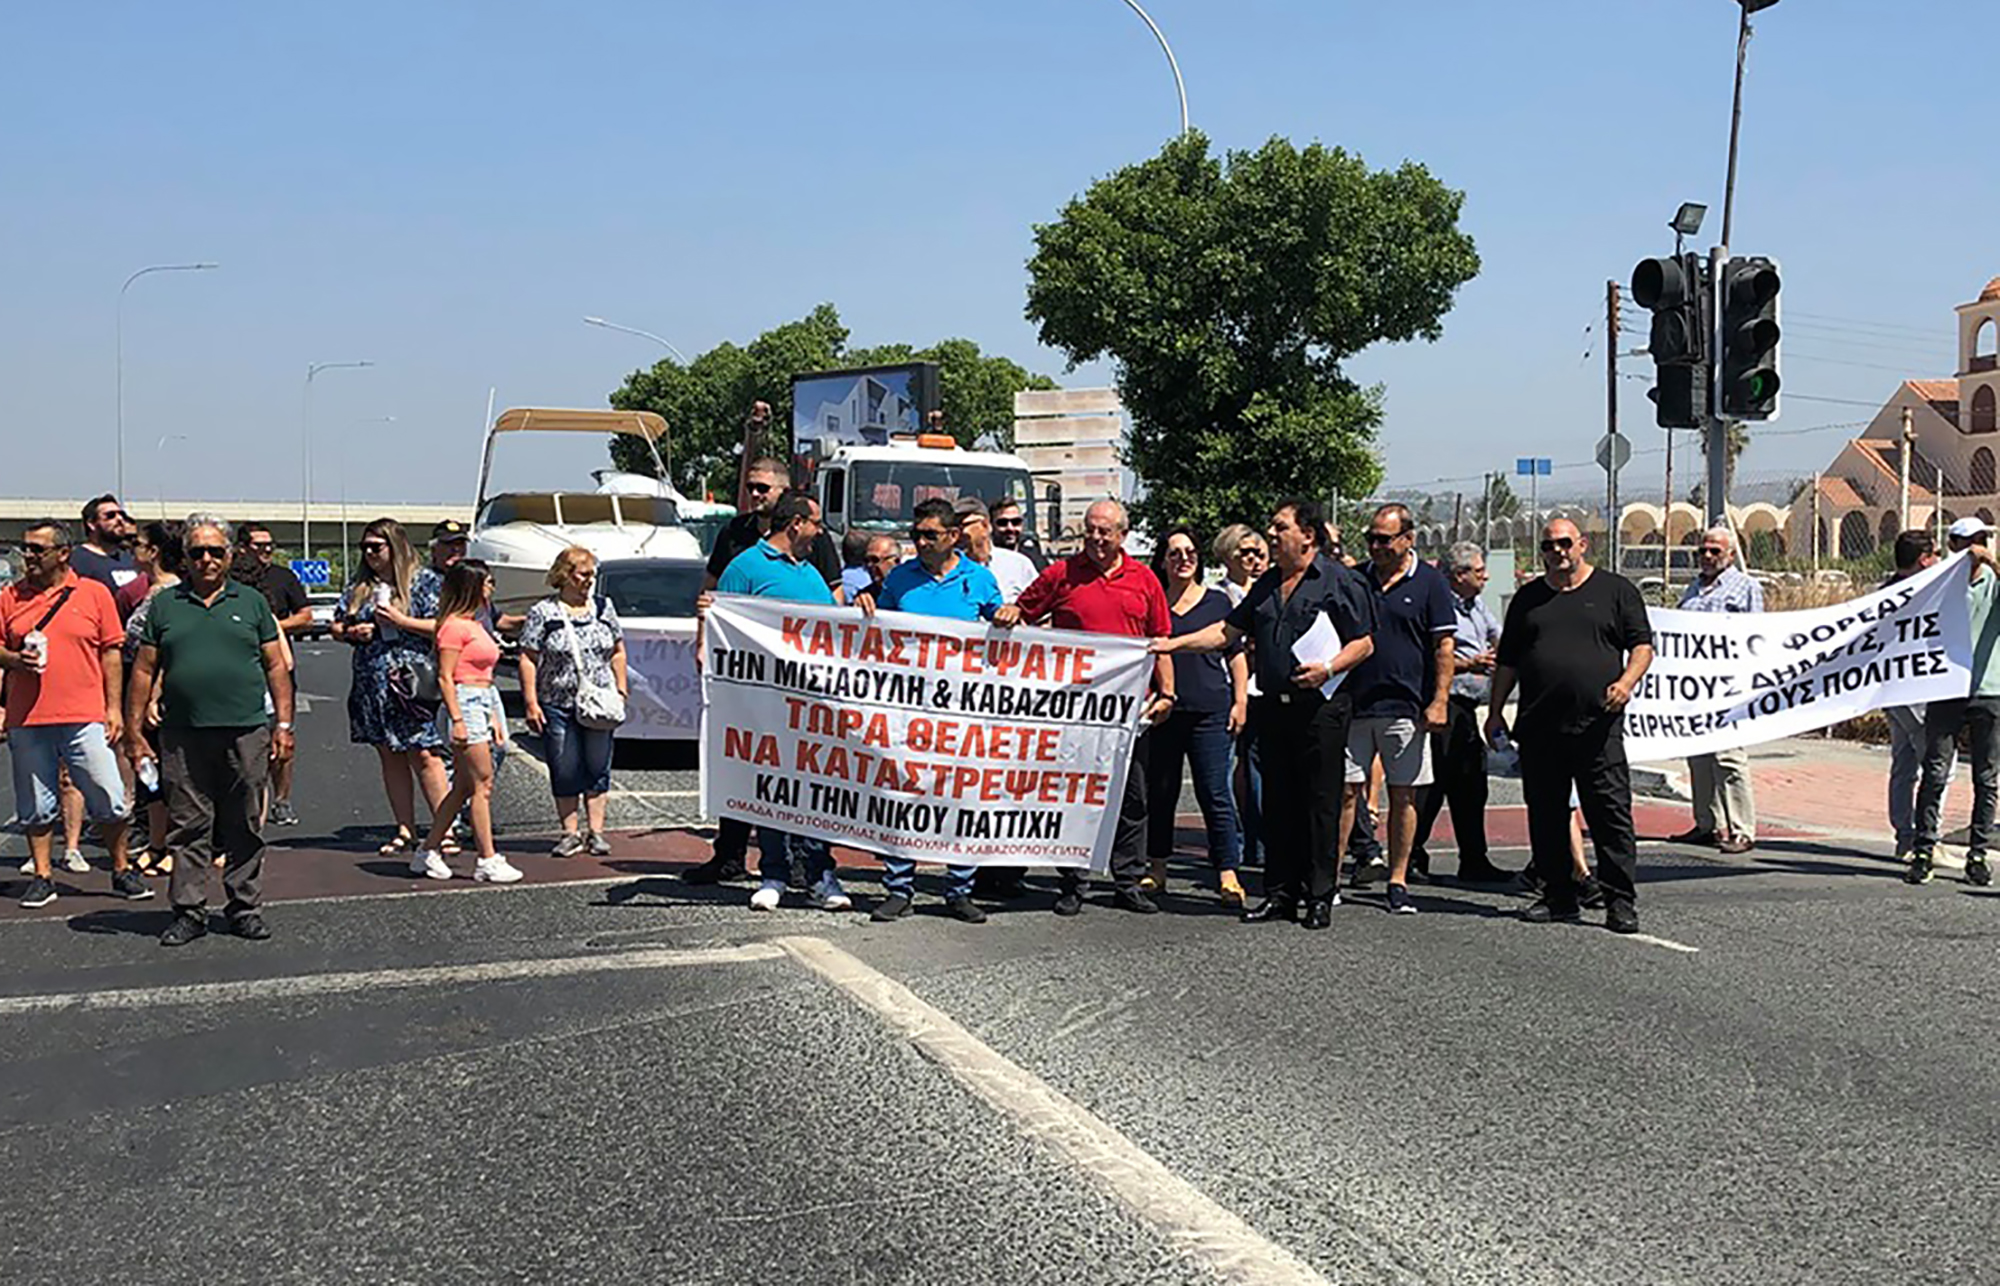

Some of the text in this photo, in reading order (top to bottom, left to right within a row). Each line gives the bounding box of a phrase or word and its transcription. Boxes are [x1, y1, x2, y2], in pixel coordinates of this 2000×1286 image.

[781, 616, 1097, 685] ΚΑΤΑΣΤΡΕΨΑΤΕ
[1782, 586, 1916, 650] ΦΟΡΕΑΣ
[713, 648, 1135, 723] ΤΗΝ ΜΙΣΙΑΟΥΛΗ & ΚΑΒΑΖΟΓΛΟΥ
[1666, 675, 1742, 701] ΤΟΥΣ
[1895, 612, 1941, 642] ΤΙΣ
[1823, 650, 1949, 697] ΠΟΛΙΤΕΣ
[785, 697, 1061, 761] ΤΩΡΑ ΘΕΛΕΤΕ
[724, 727, 1109, 806] ΝΑ ΚΑΤΑΣΤΡΕΨΕΤΕ
[726, 798, 773, 818] ΟΜΑΔΑ
[775, 811, 878, 841] ΠΡΩΤΟΒΟΥΛΙΑΣ
[756, 773, 1063, 839] ΚΑΙ ΤΗΝ ΝΙΚΟΥ ΠΑΤΤΙΧΗ
